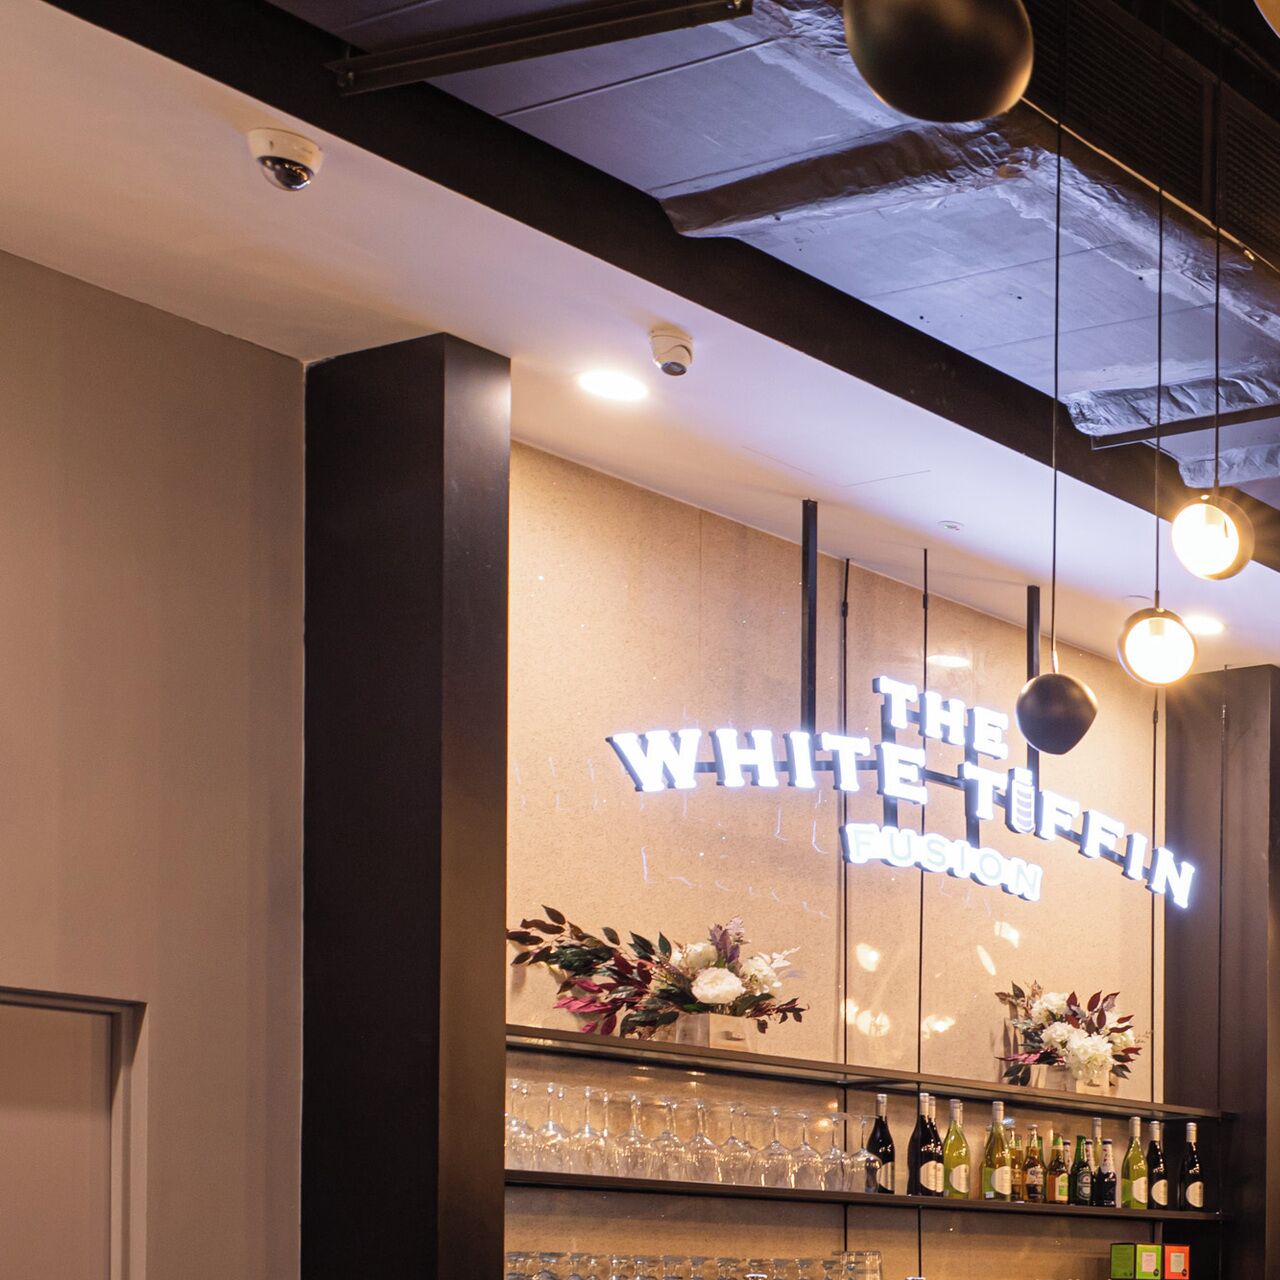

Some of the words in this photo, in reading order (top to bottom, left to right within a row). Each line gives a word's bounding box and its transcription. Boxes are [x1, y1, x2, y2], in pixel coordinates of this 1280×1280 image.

[875, 676, 1009, 760] THE
[608, 729, 927, 804] WHITE
[846, 824, 1043, 901] FUSION
